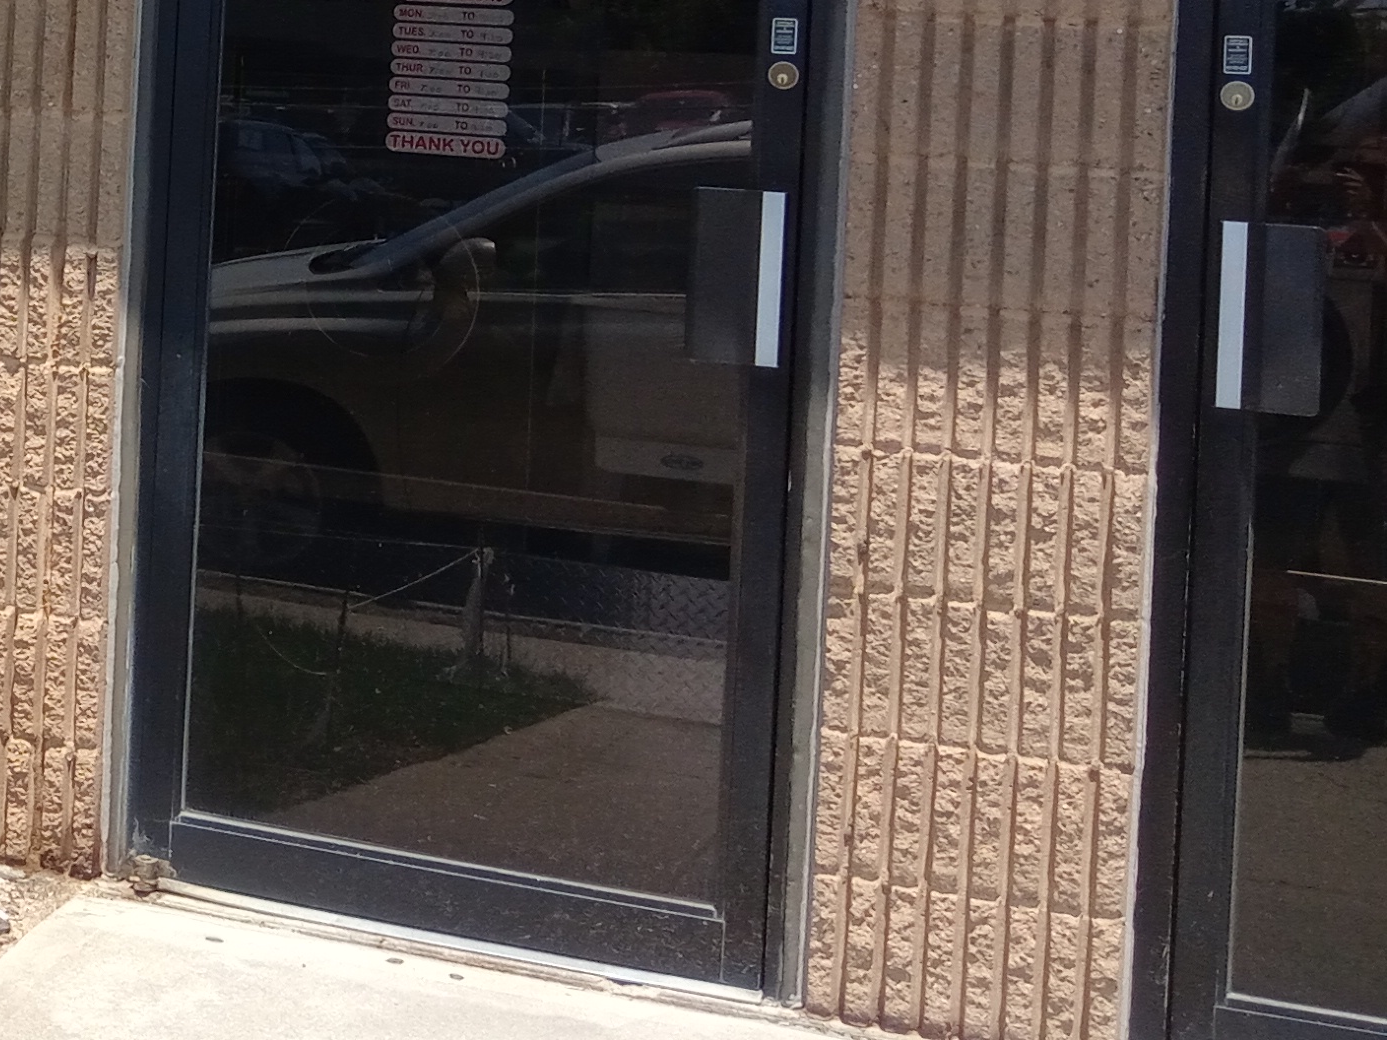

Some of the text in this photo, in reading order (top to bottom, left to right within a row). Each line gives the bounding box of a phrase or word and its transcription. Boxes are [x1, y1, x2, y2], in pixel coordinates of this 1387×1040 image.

[462, 12, 475, 20] TO
[461, 29, 474, 39] TO
[459, 48, 473, 57] TO
[459, 66, 472, 75] TO
[457, 84, 471, 94] TO
[456, 103, 469, 112] TO
[455, 121, 468, 130] TO
[391, 134, 500, 155] THANK YOU
